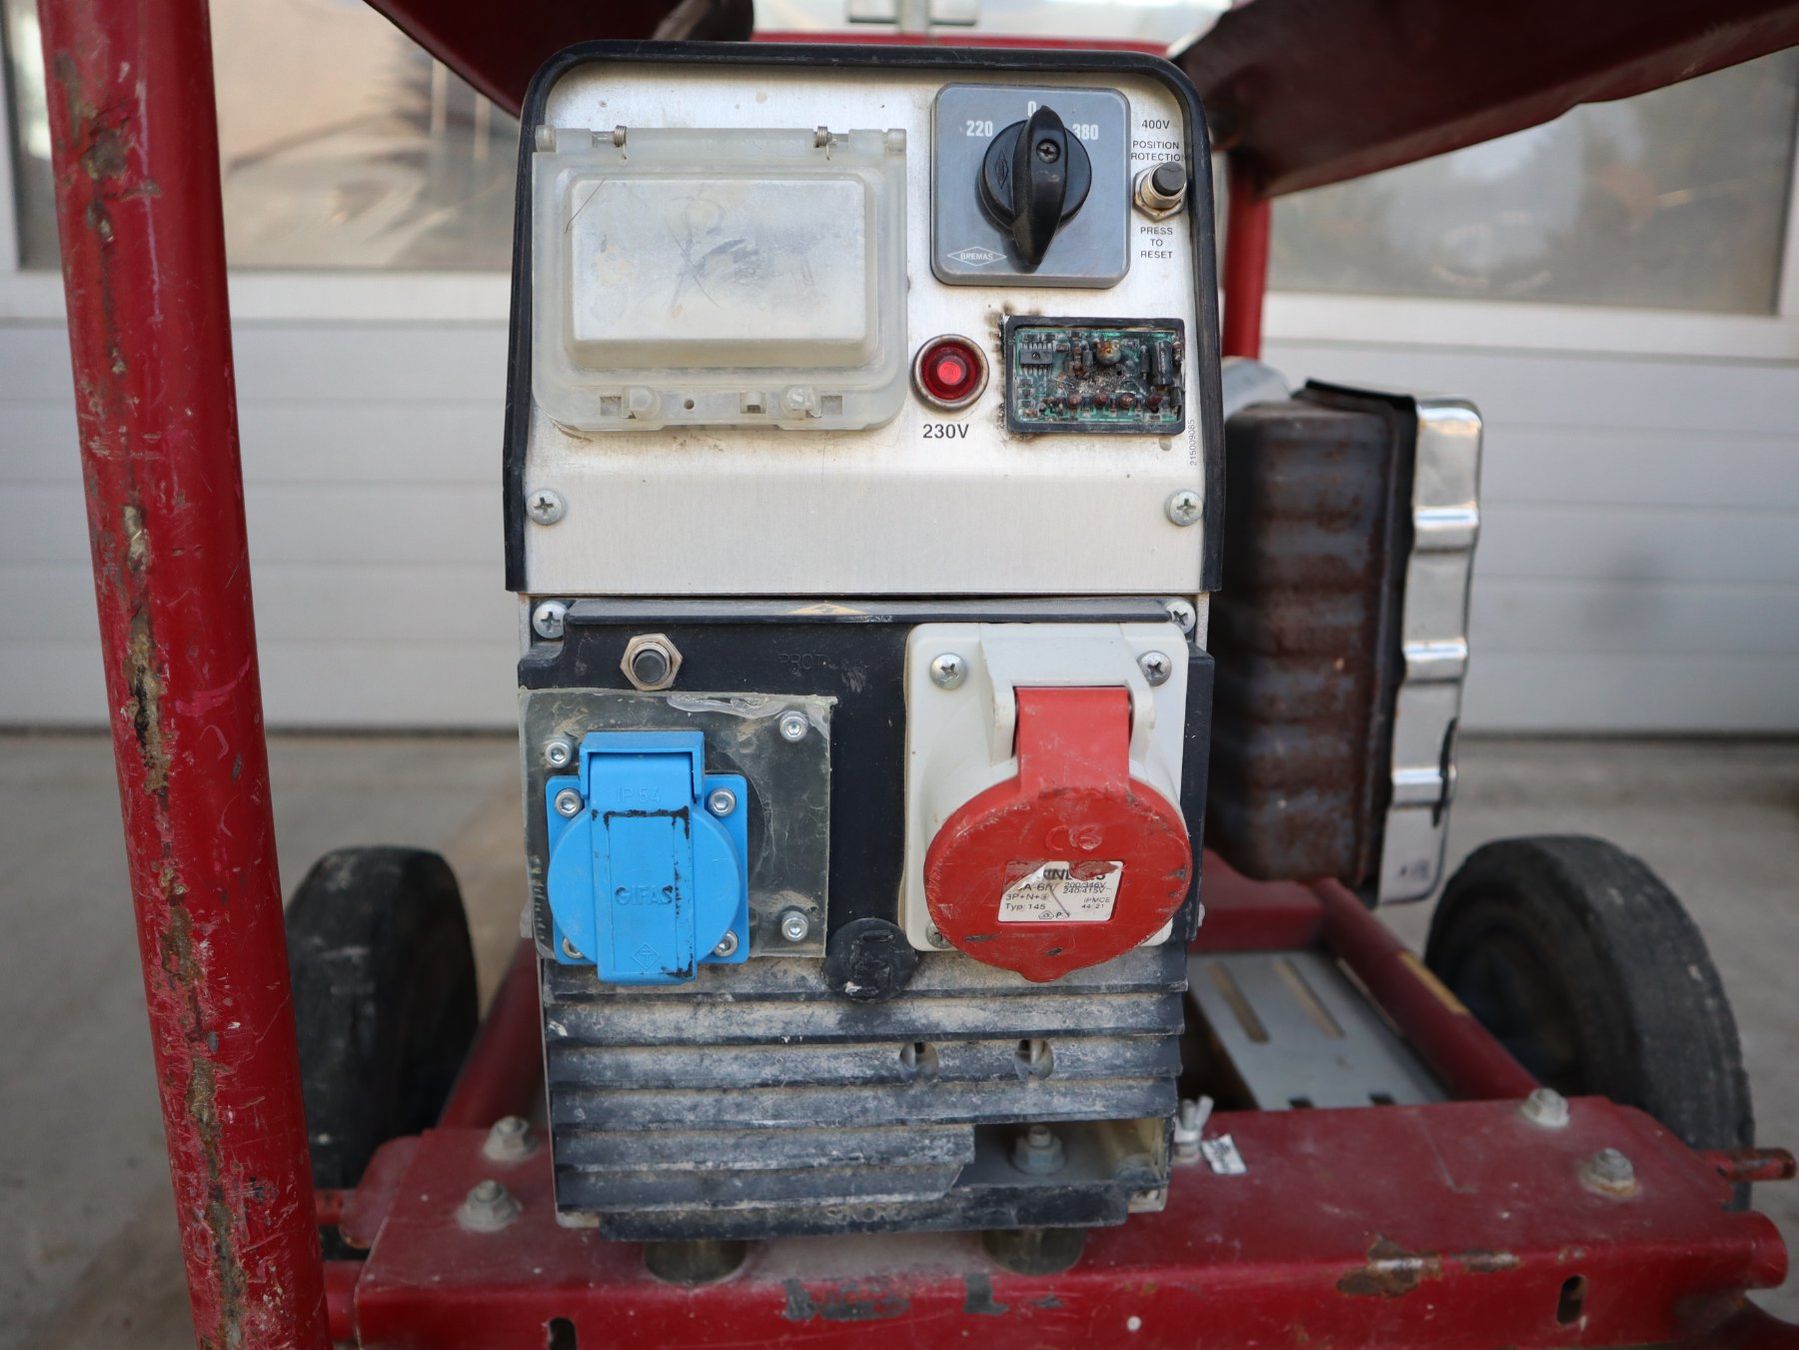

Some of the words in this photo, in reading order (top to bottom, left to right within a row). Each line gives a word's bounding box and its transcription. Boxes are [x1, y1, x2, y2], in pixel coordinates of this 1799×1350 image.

[1027, 101, 1037, 118] 0
[965, 120, 993, 138] 220
[1141, 119, 1170, 130] 400V
[1072, 123, 1099, 141] 380
[1132, 140, 1180, 150] POSITION
[1140, 226, 1173, 236] PRESS
[1150, 238, 1163, 247] TO
[960, 251, 994, 261] BREMAS
[1140, 250, 1173, 260] RESET
[922, 423, 970, 439] 230V
